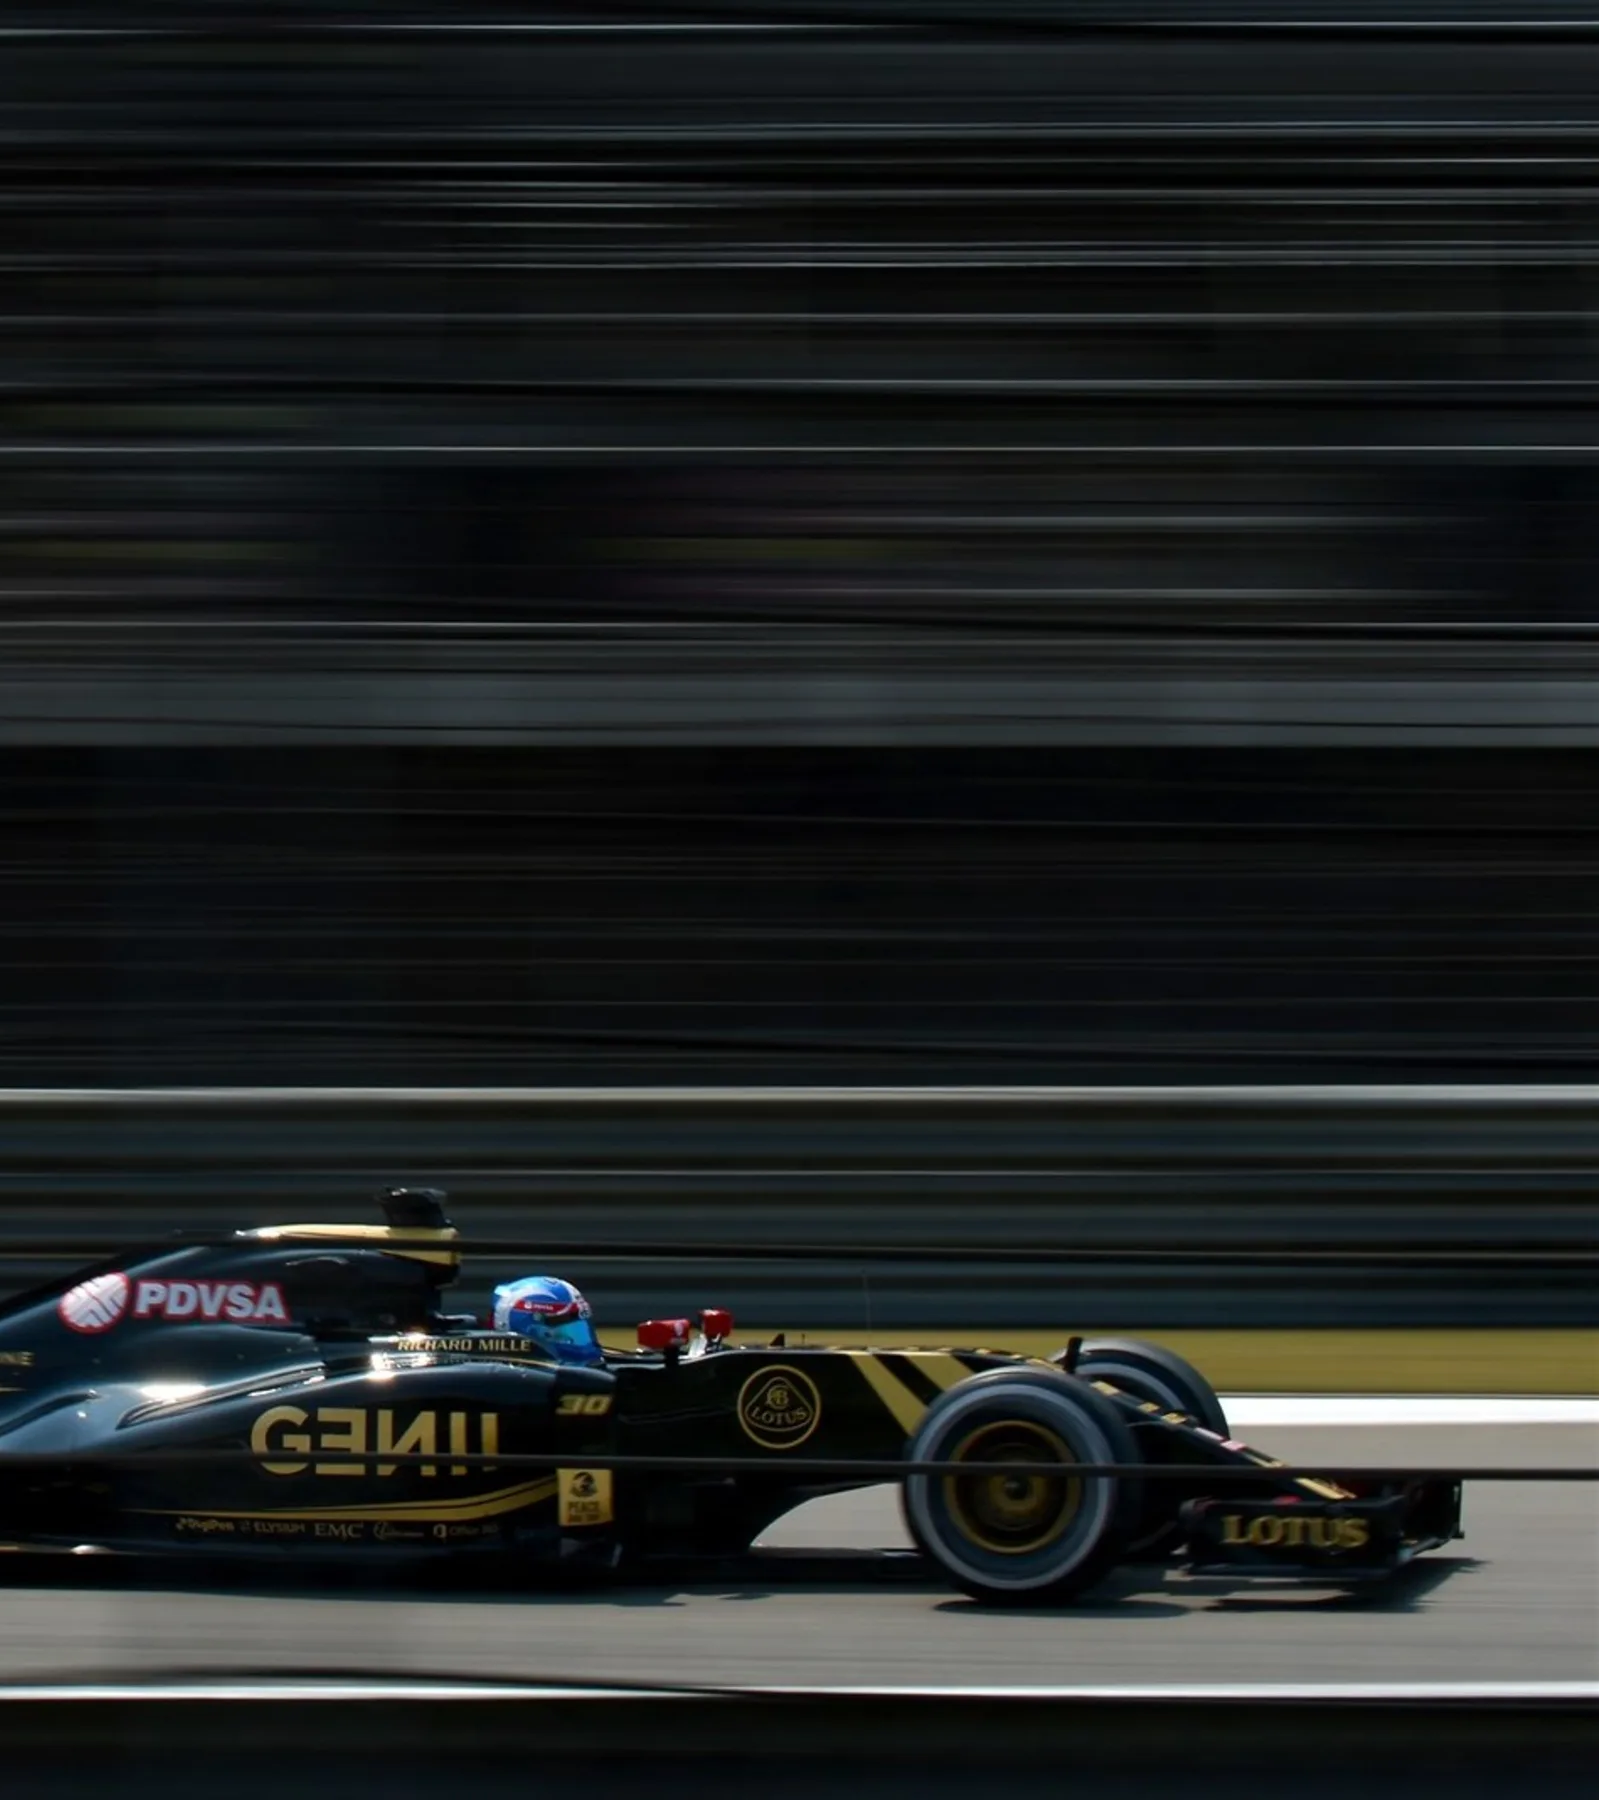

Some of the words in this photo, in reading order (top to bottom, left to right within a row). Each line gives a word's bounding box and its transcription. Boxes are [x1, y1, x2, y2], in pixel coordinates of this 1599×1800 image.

[137, 1282, 287, 1320] PDVSA
[398, 1340, 473, 1351] RICHARD
[478, 1340, 531, 1352] MILLE
[555, 1394, 614, 1417] 30
[750, 1406, 808, 1426] LOTUS
[253, 1521, 306, 1533] ELYSIUM
[1221, 1514, 1371, 1549] LOTUS
